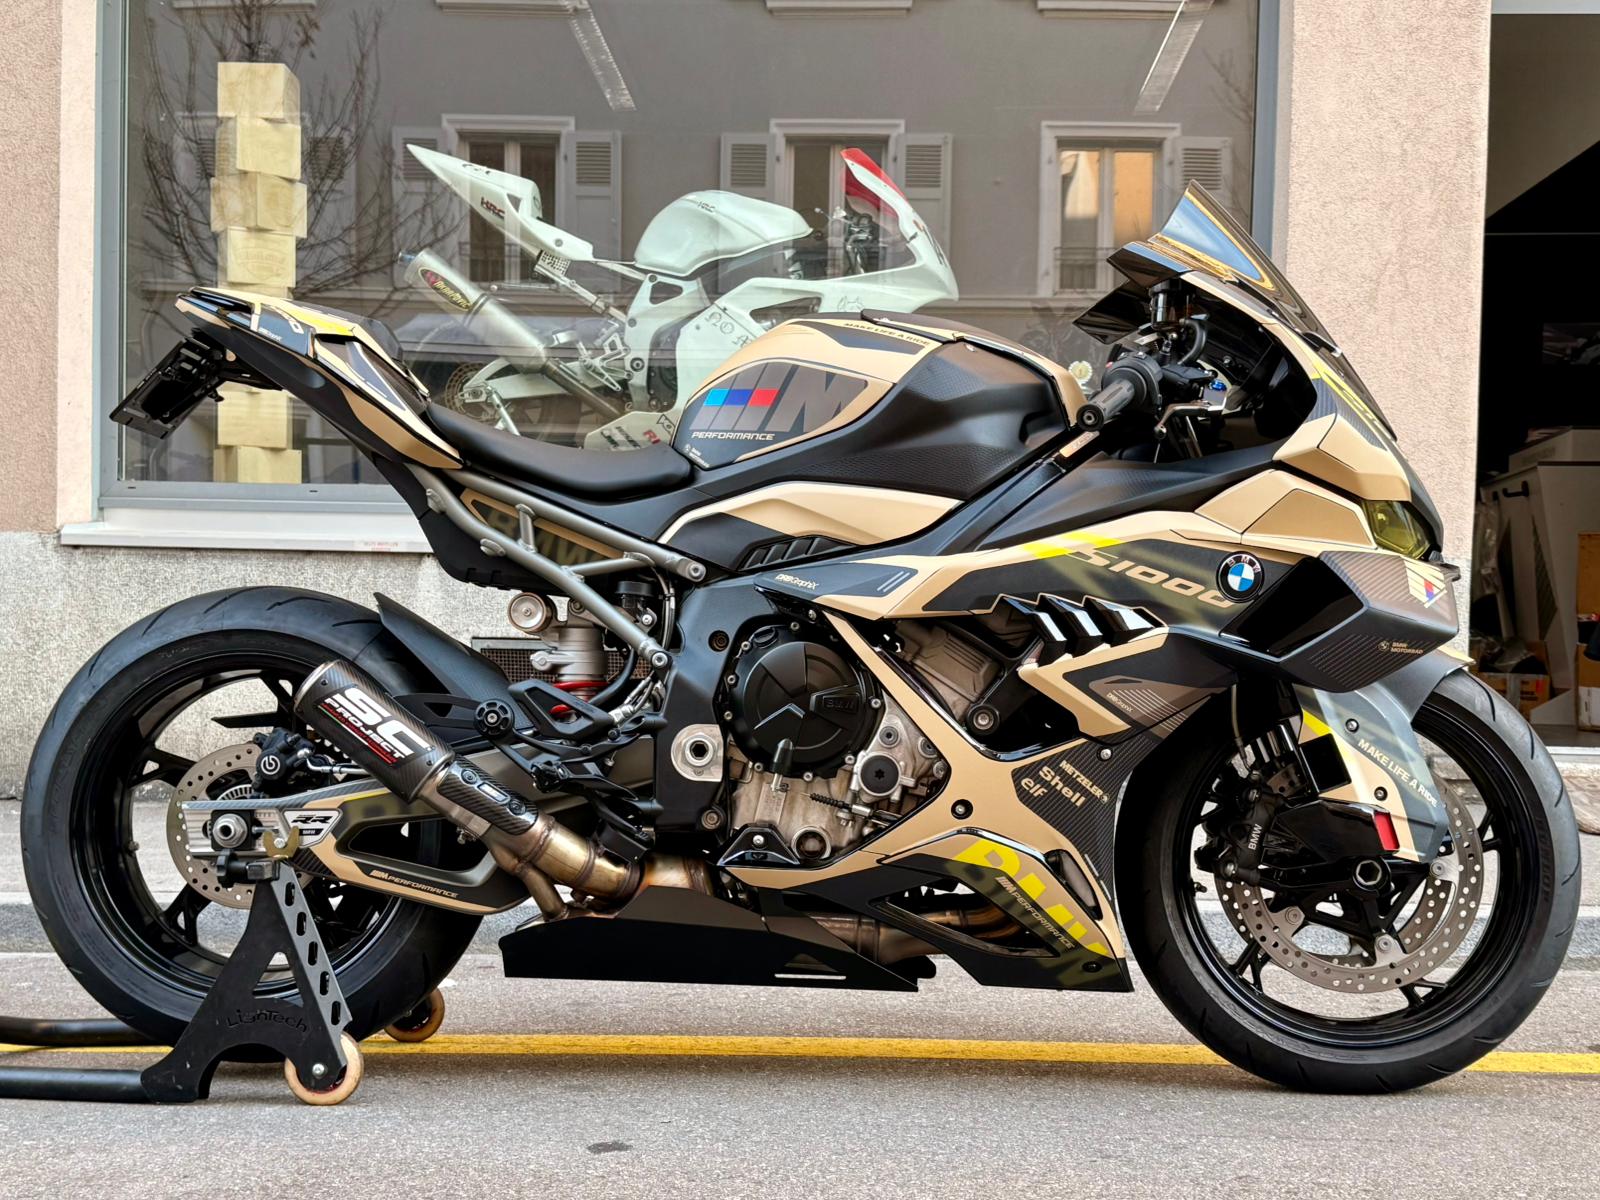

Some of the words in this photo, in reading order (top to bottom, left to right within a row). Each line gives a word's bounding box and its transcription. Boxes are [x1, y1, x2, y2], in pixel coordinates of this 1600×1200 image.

[481, 197, 505, 219] HRC
[691, 431, 775, 441] PERFORMANCE
[1391, 641, 1408, 649] BMW
[324, 698, 405, 758] PROJECT
[1039, 766, 1086, 807] Shell
[1059, 760, 1104, 799] METZELER
[1358, 738, 1389, 766] MAKE
[1387, 761, 1410, 783] LIFE
[1409, 779, 1418, 789] A
[1418, 784, 1437, 808] RIDE
[1021, 778, 1048, 797] elf
[1248, 823, 1262, 851] BMW
[387, 875, 459, 899] PERFORMANCE
[1011, 890, 1076, 949] PERFORMANCE
